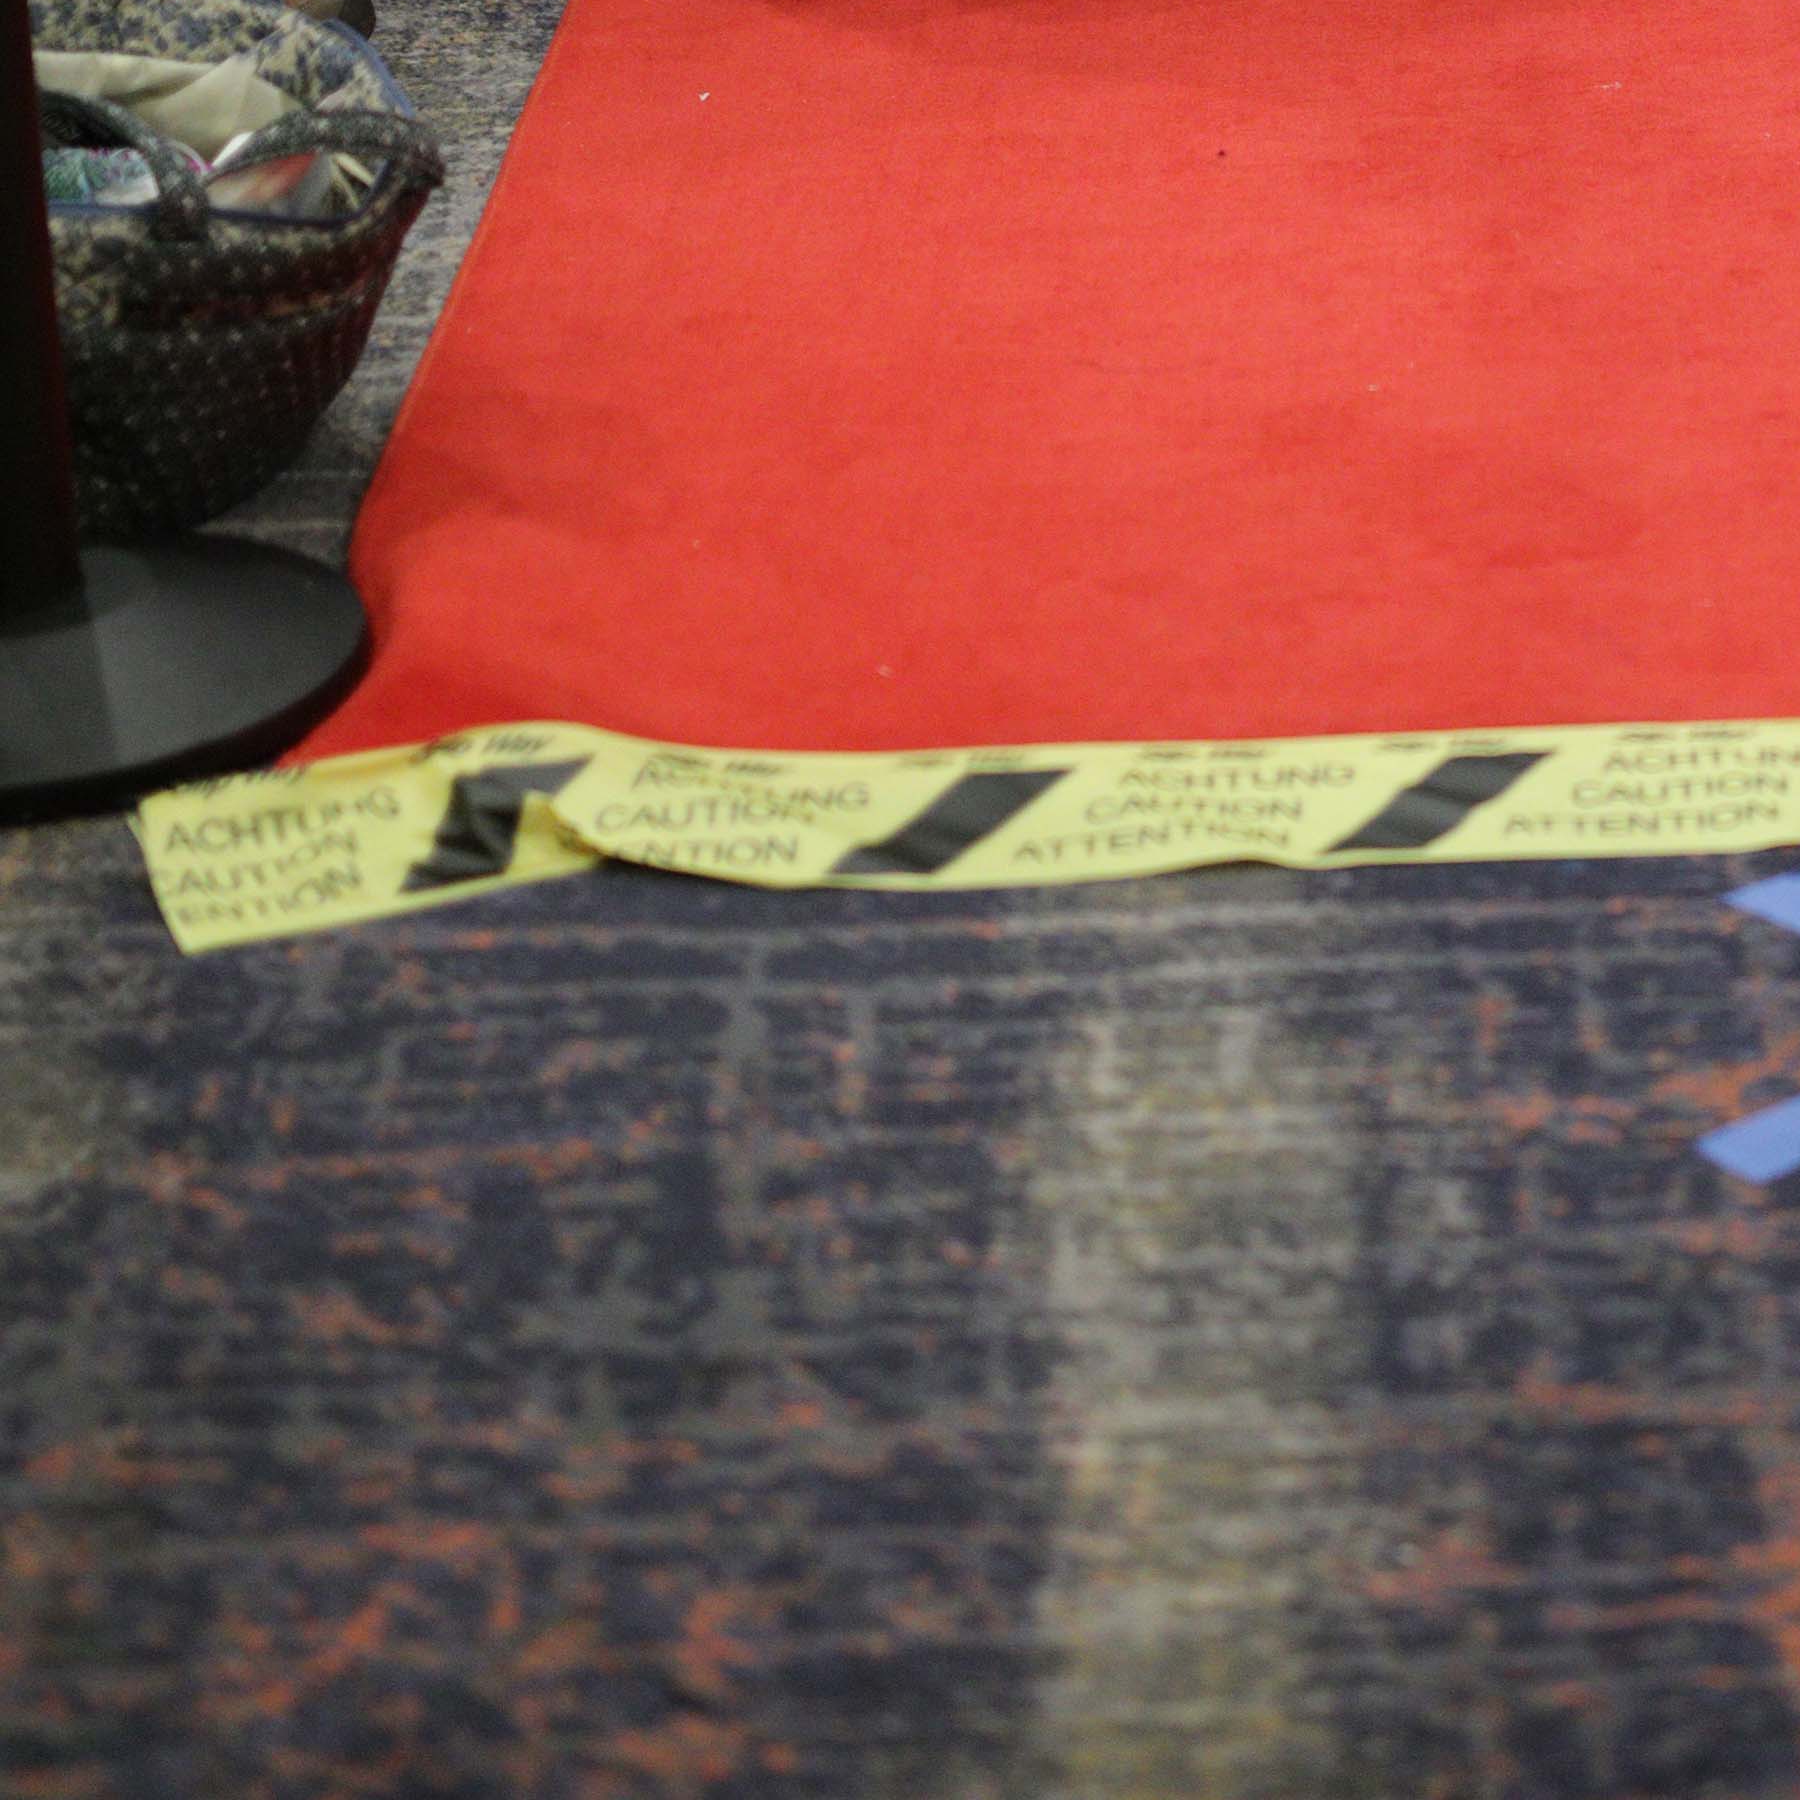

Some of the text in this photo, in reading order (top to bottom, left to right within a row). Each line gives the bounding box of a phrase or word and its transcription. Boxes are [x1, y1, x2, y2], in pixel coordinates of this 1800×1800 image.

[1117, 764, 1356, 789] ACHTUNG
[1571, 774, 1788, 807] CAUTION
[595, 798, 816, 834] CAUTION
[1086, 796, 1304, 824] CAUTION
[1503, 800, 1780, 836] ATTENTION
[1012, 822, 1291, 863] ATTENTION
